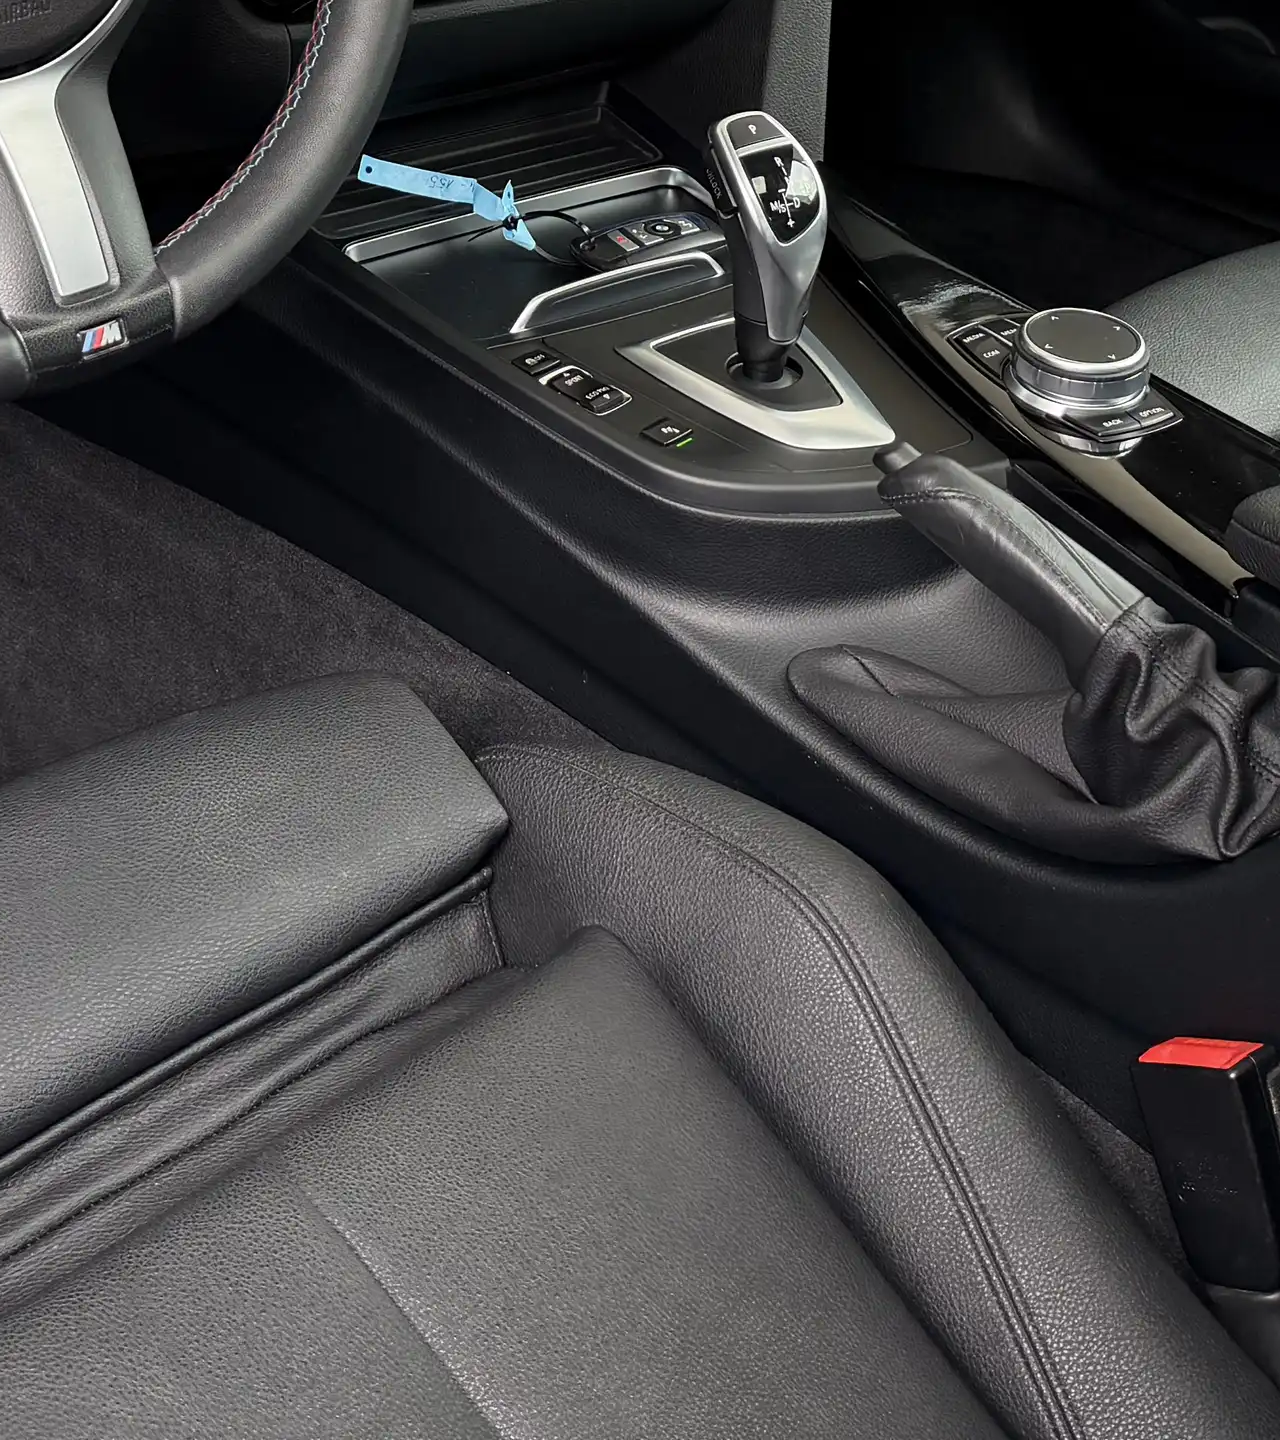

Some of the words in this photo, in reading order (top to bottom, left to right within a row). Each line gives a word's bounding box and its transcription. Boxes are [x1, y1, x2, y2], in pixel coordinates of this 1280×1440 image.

[748, 124, 757, 135] P
[773, 156, 785, 168] R
[793, 197, 801, 209] D
[983, 349, 1000, 358] COM
[564, 374, 584, 387] SPORT
[1138, 406, 1166, 418] OPTION
[1102, 418, 1124, 427] BACK
